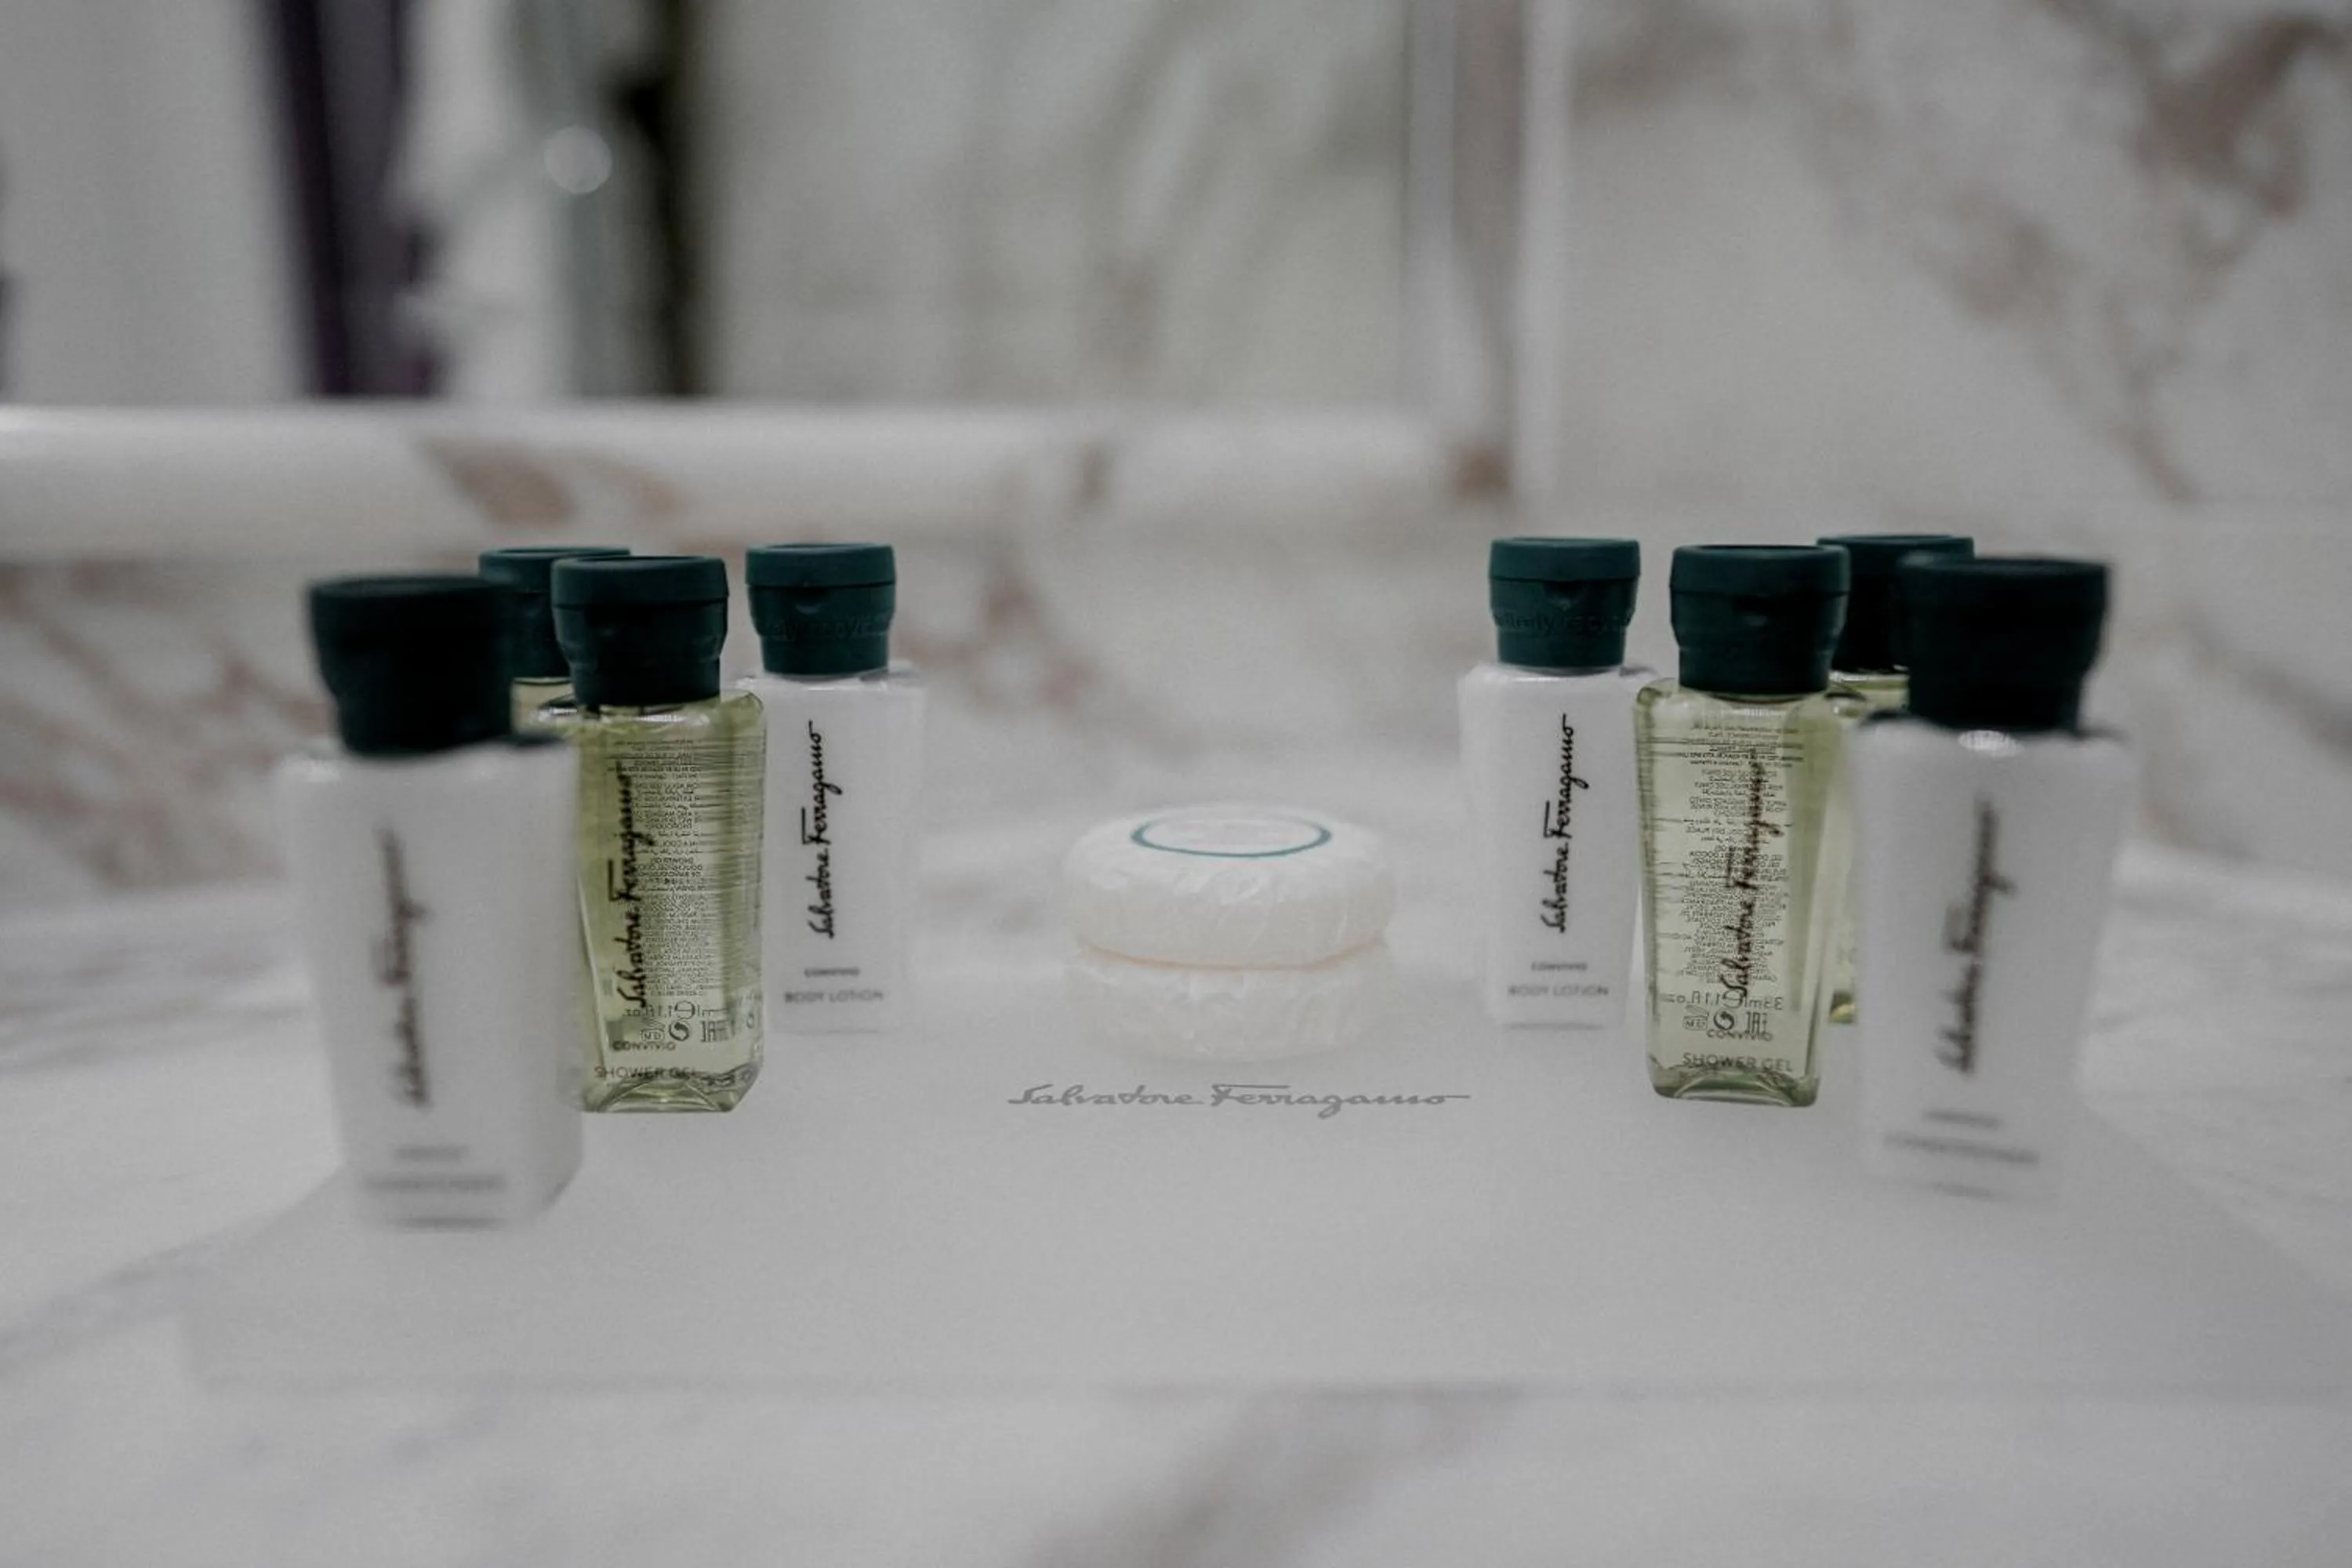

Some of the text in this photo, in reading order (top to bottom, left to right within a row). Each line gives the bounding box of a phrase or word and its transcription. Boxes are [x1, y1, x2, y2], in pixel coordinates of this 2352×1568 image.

[800, 720, 843, 939] Salvatore Ferragamo
[1541, 713, 1590, 933] Salvatore Ferragamo
[608, 758, 655, 1008] Salvatore Ferragamo
[1719, 897, 1756, 995] Salvatore
[784, 989, 884, 1004] BODY LOTION
[1508, 984, 1610, 997] BODY LOTION
[1682, 1052, 1793, 1072] SHOWER GEL
[1008, 1083, 1471, 1120] Salvatore Ferragamo
